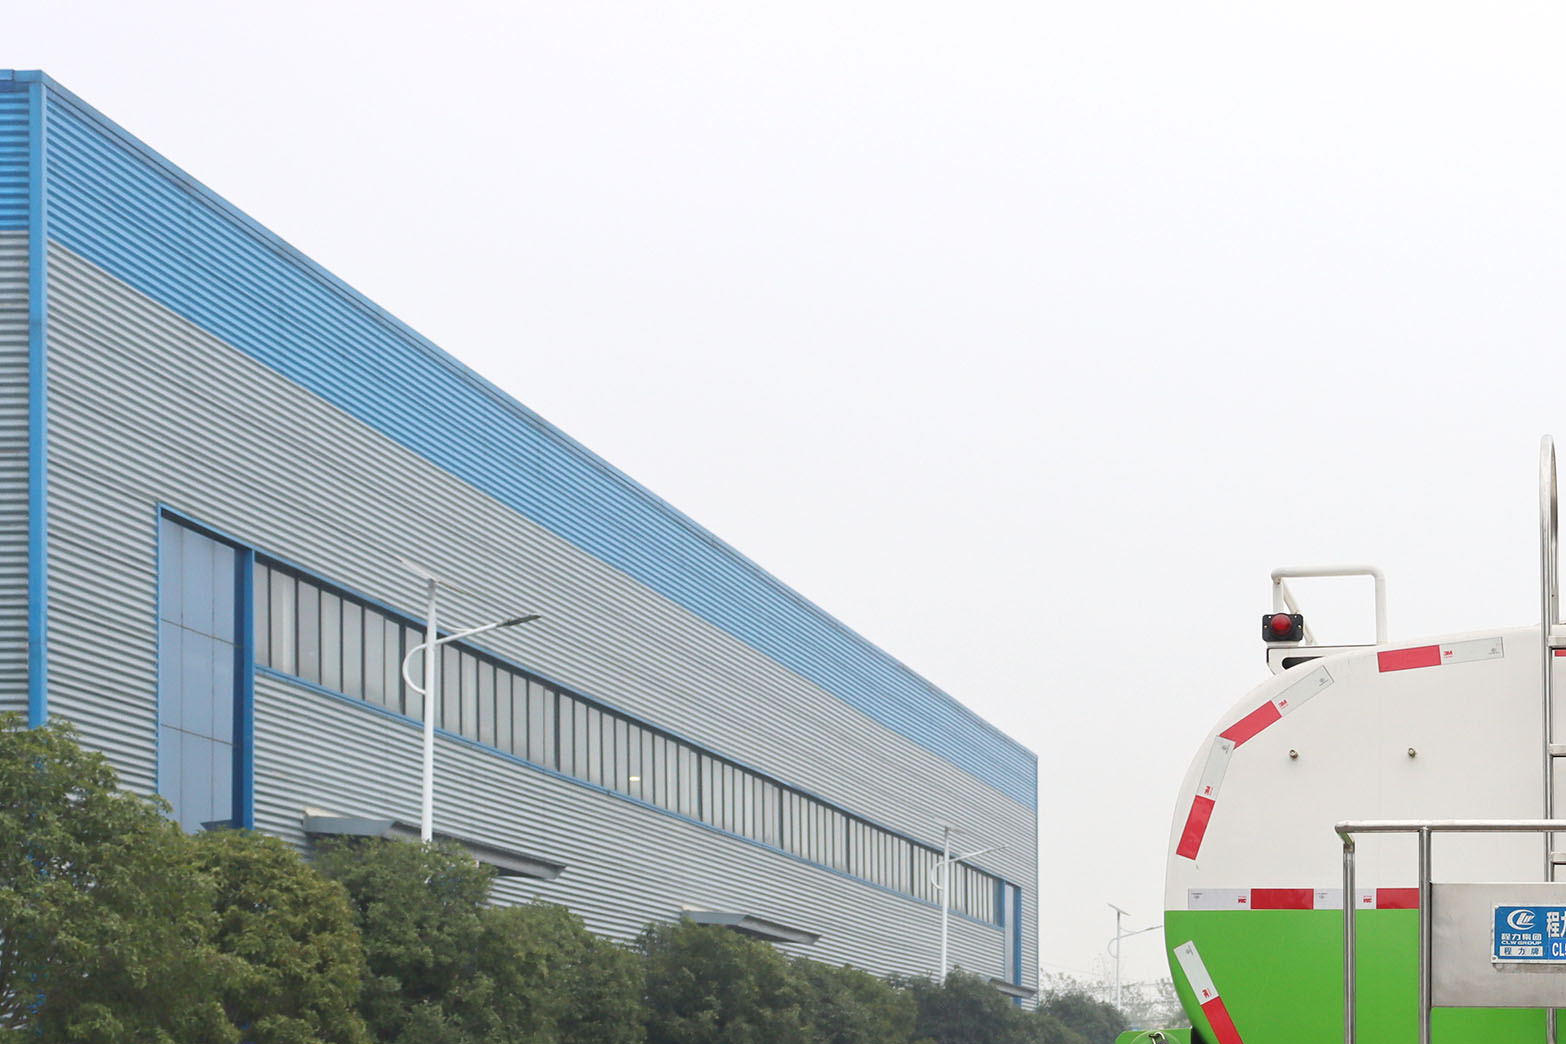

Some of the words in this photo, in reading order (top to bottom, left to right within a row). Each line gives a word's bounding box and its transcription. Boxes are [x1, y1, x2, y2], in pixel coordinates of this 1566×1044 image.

[1501, 933, 1542, 941] 程力集团
[1504, 947, 1539, 955] 程力牌
